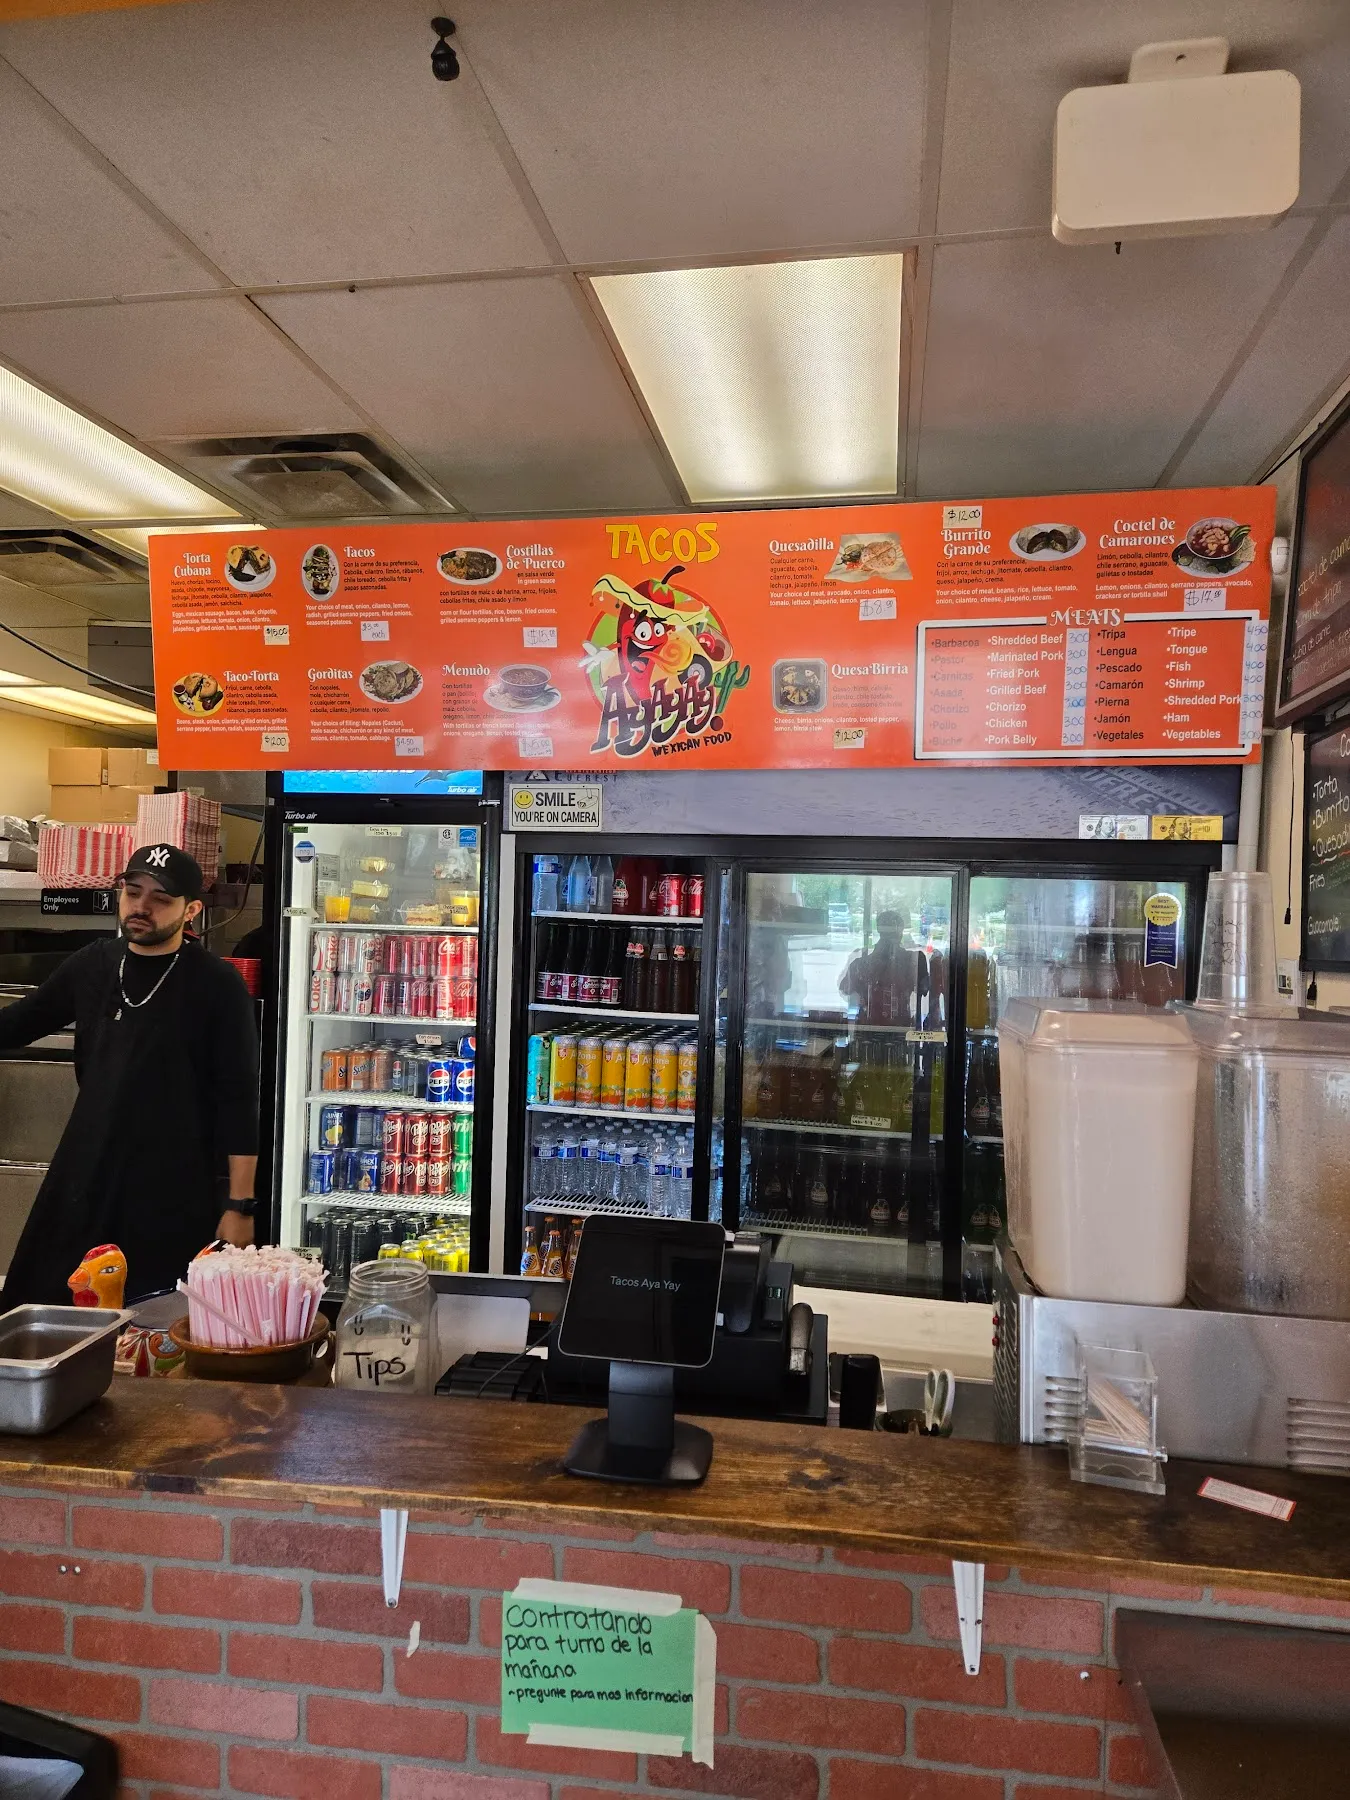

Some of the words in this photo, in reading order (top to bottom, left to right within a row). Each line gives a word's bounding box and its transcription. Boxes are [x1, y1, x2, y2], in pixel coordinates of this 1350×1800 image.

[1114, 518, 1155, 534] Coctel
[1160, 517, 1175, 530] de
[941, 528, 991, 542] Burrito
[1100, 534, 1175, 548] Camarones
[606, 522, 720, 564] TACOS
[769, 538, 834, 556] Quesadilla
[344, 546, 375, 558] Tacos
[506, 544, 553, 557] Costillas
[943, 541, 990, 559] Grande
[183, 552, 210, 564] Torta
[507, 556, 520, 569] de
[523, 558, 564, 569] Puerco
[174, 566, 211, 577] Cubana
[1050, 608, 1121, 627] MEATS
[1101, 630, 1126, 640] Tripa
[1171, 627, 1196, 639] Tripe
[991, 635, 1039, 645] Shredded
[1041, 634, 1063, 644] Beef
[991, 652, 1038, 662] Marinated
[1041, 650, 1063, 660] Pork
[1100, 646, 1137, 658] Lengua
[1171, 644, 1207, 656] Tongue
[442, 662, 490, 676] Menudo
[1099, 663, 1142, 672] Pescado
[1170, 661, 1191, 671] Fish
[224, 671, 278, 682] Taco-Torta
[308, 668, 353, 682] Gorditas
[990, 669, 1014, 678] Fried
[1017, 668, 1039, 678] Pork
[990, 686, 1021, 695] Grilled
[1024, 685, 1046, 694] Beef
[1098, 680, 1143, 690] Camarón
[1169, 678, 1205, 690] Shrimp
[1098, 697, 1129, 706] Pierna
[1168, 695, 1216, 705] Shredded
[1219, 694, 1241, 704] Pork
[989, 702, 1026, 711] Chorizo
[989, 718, 1027, 728] Chicken
[1098, 713, 1130, 723] Jamón
[1167, 713, 1190, 722] Ham
[989, 735, 1010, 744] Pork
[1014, 735, 1036, 746] Belly
[1096, 730, 1144, 742] Vegetales
[1166, 729, 1220, 741] Vegetables
[652, 738, 700, 757] MEXICAN
[703, 732, 732, 746] FOOD
[1314, 775, 1338, 802] Torta
[535, 792, 576, 806] SMILE
[285, 811, 305, 820] Turbo
[514, 812, 544, 822] YOU'RE
[547, 812, 558, 822] ON
[561, 812, 596, 822] CAMERA
[1316, 792, 1350, 830] Burrito
[145, 847, 170, 867] NY
[1309, 873, 1325, 892] Fries
[43, 896, 79, 904] Employees
[43, 904, 59, 912] Only
[311, 976, 320, 1012] Coke
[610, 1275, 639, 1287] Tacos
[641, 1278, 660, 1290] Aya
[663, 1280, 680, 1292] Yay
[343, 1351, 406, 1386] Tips
[506, 1604, 652, 1634] Contratando
[505, 1634, 549, 1656] para
[555, 1634, 604, 1654] turno
[611, 1635, 632, 1653] de
[639, 1637, 653, 1655] la
[505, 1659, 576, 1679] mañana
[570, 1689, 595, 1705] para
[596, 1690, 621, 1701] mas
[625, 1688, 694, 1704] informacion
